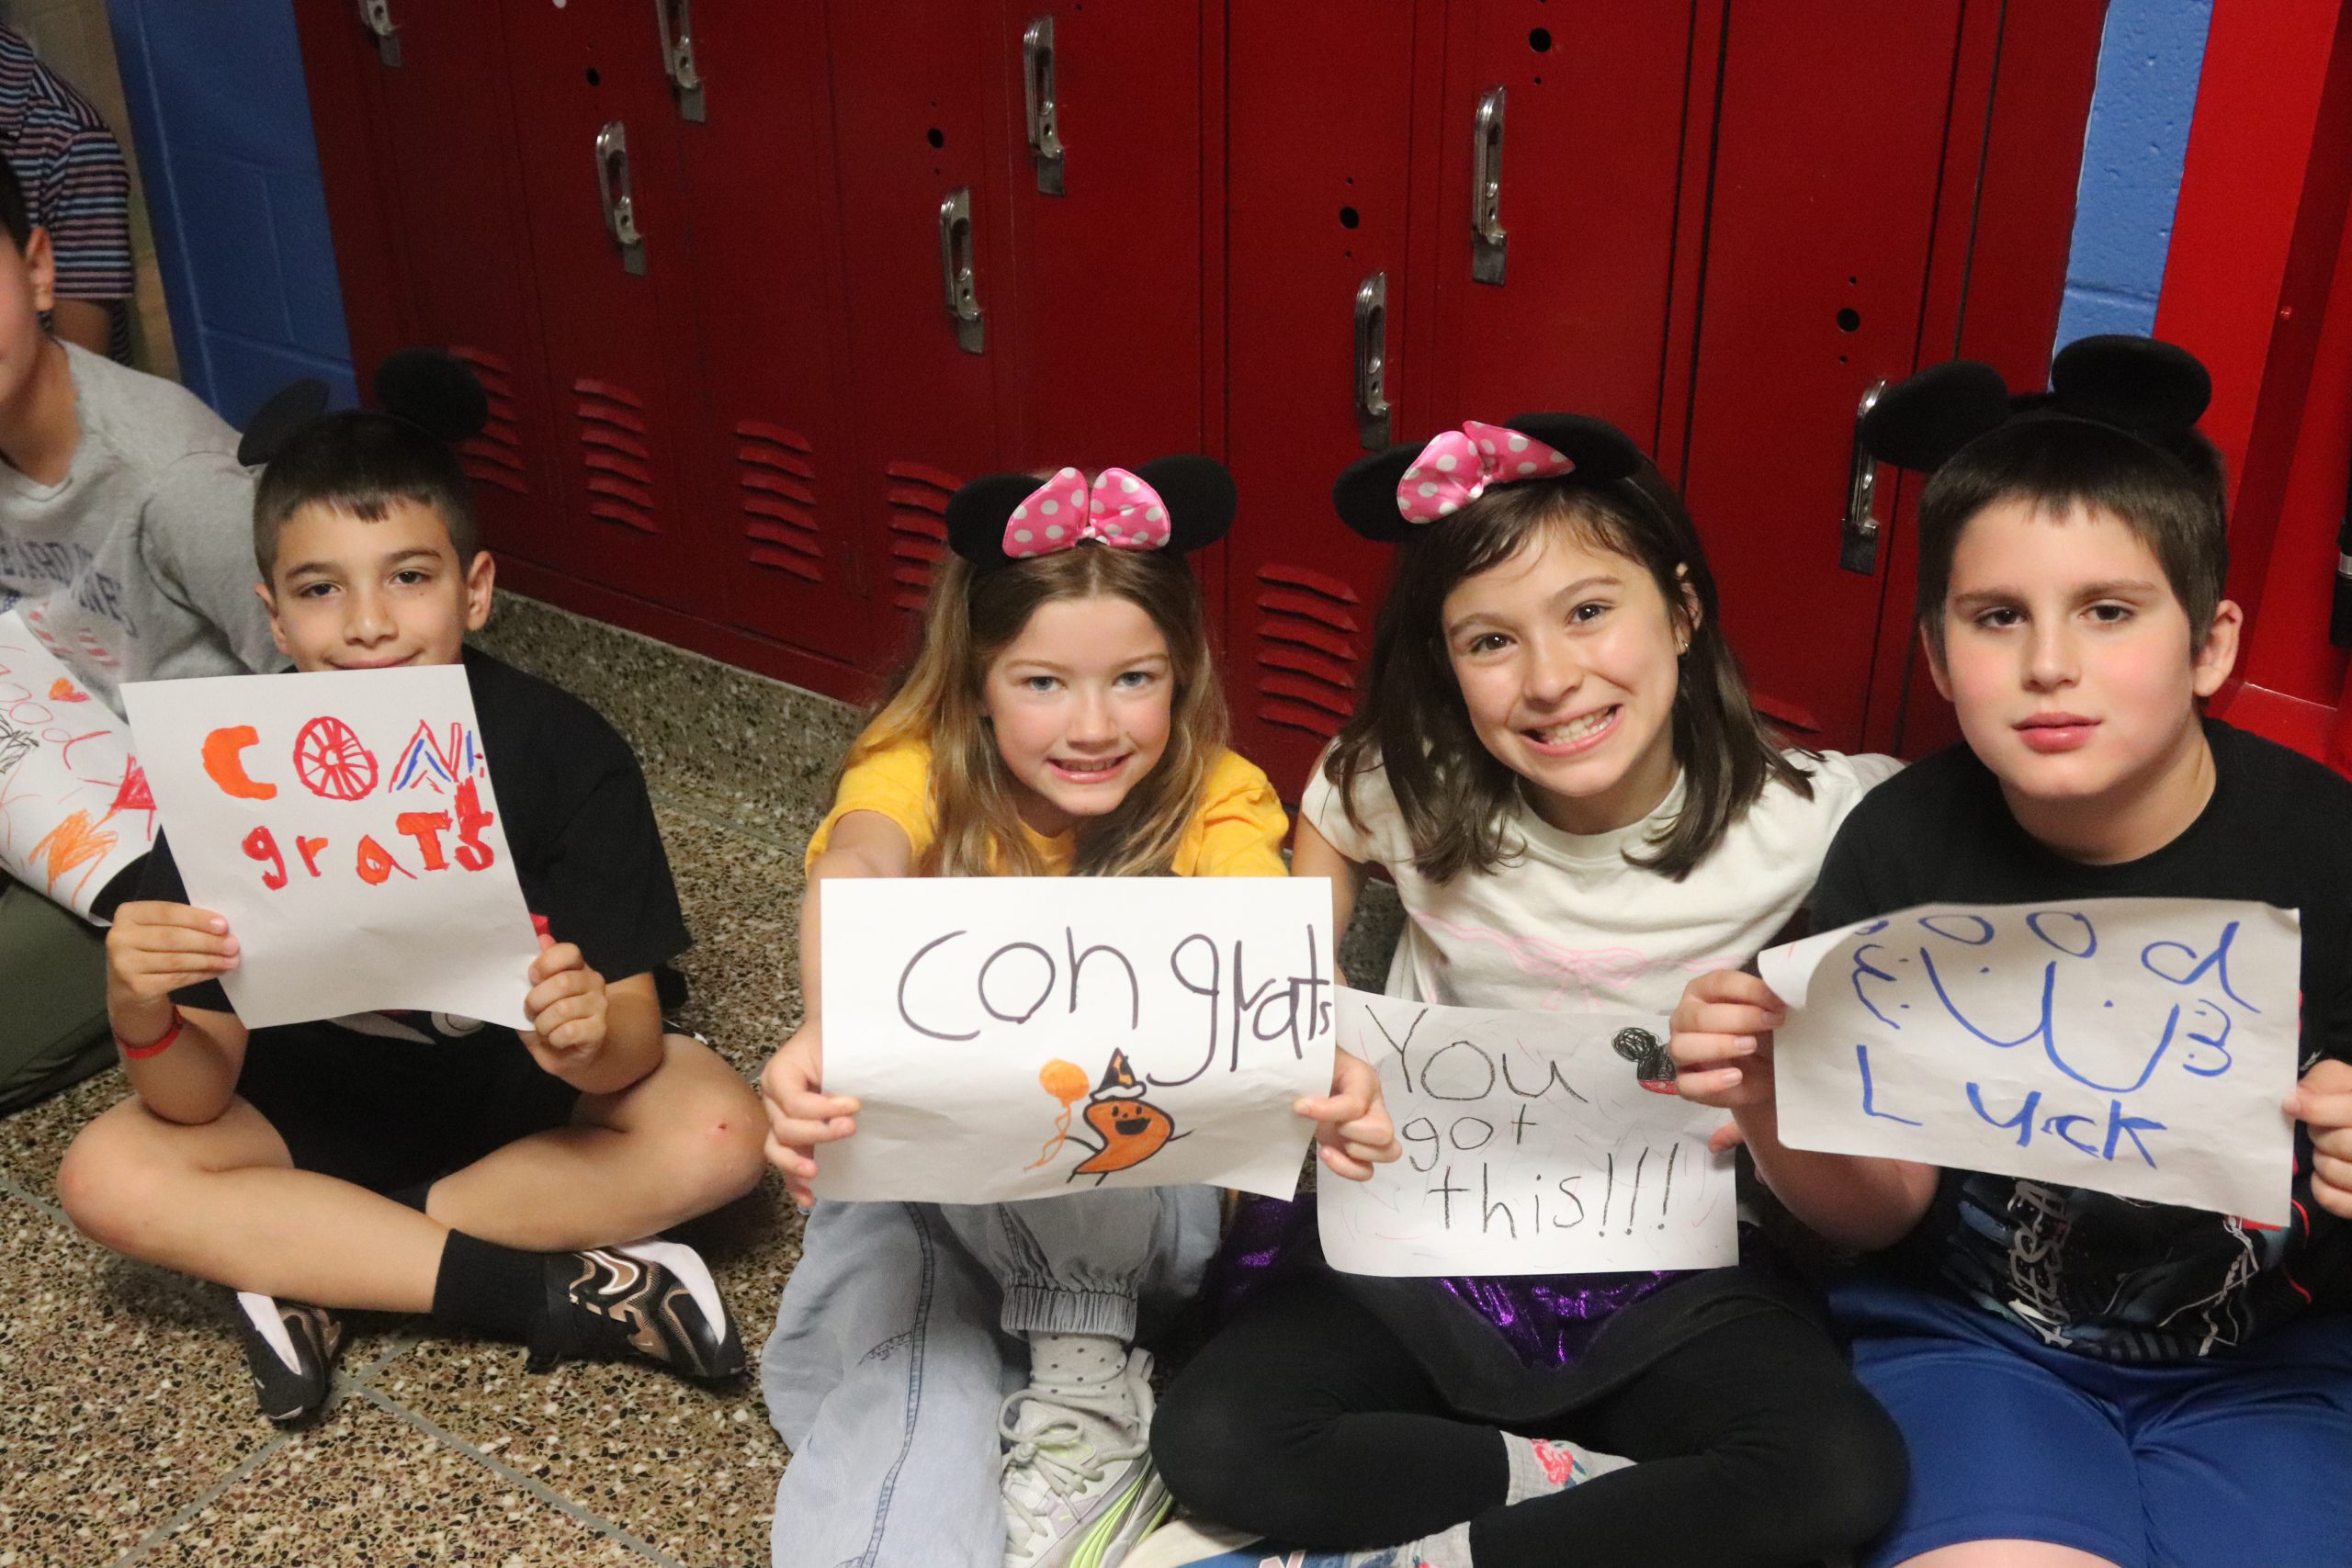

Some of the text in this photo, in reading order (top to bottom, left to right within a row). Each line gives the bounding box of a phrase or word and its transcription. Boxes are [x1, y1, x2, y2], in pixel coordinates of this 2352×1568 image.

[897, 923, 1333, 1087] Congrats
[1401, 1103, 1539, 1172] got
[1427, 1142, 1679, 1239] this!!!
